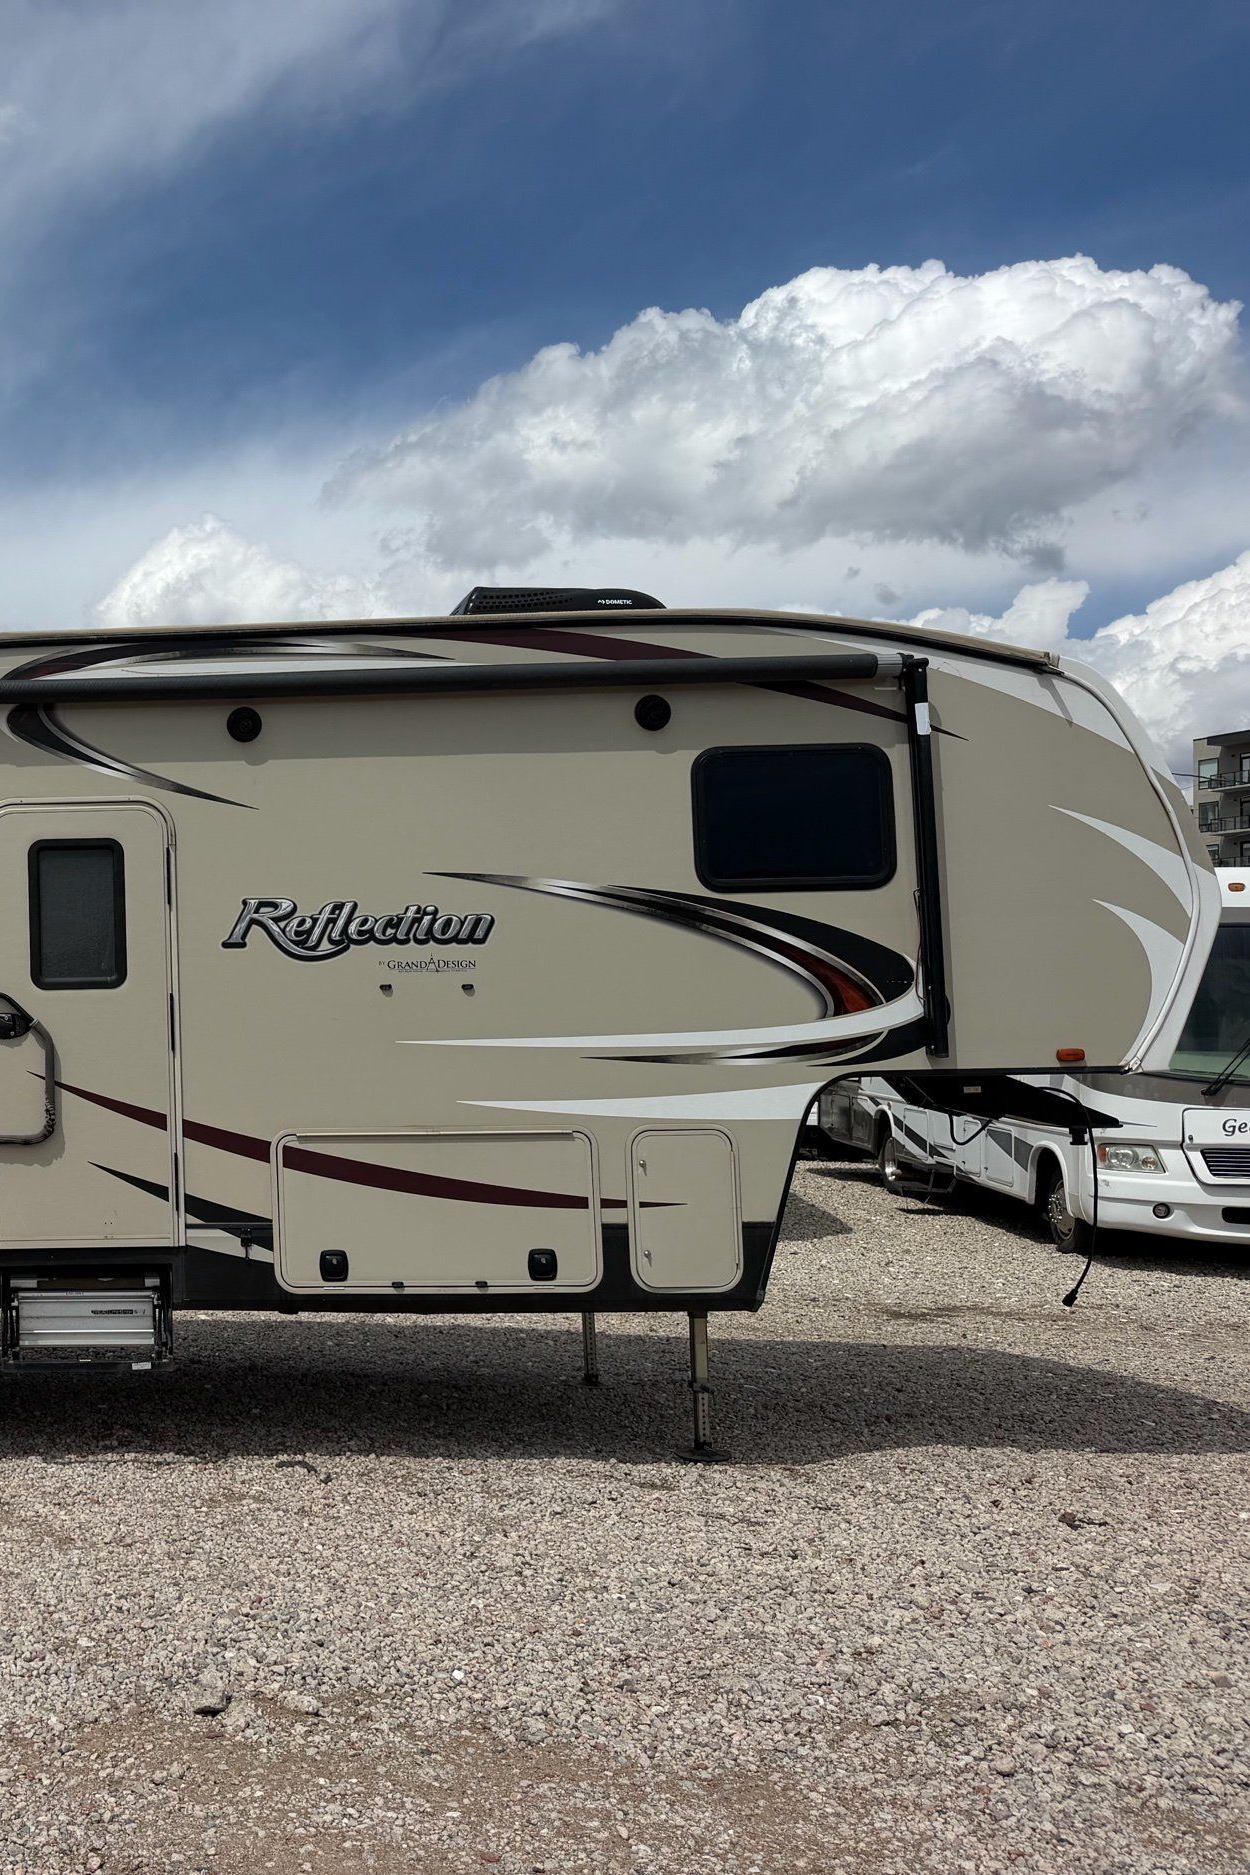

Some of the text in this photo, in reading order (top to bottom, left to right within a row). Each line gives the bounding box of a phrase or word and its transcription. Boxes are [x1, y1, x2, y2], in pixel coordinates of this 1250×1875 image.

[221, 897, 495, 962] Reflection
[387, 960, 428, 970] GRAND
[437, 960, 477, 969] DESIGN
[1222, 1118, 1250, 1136] Ge
